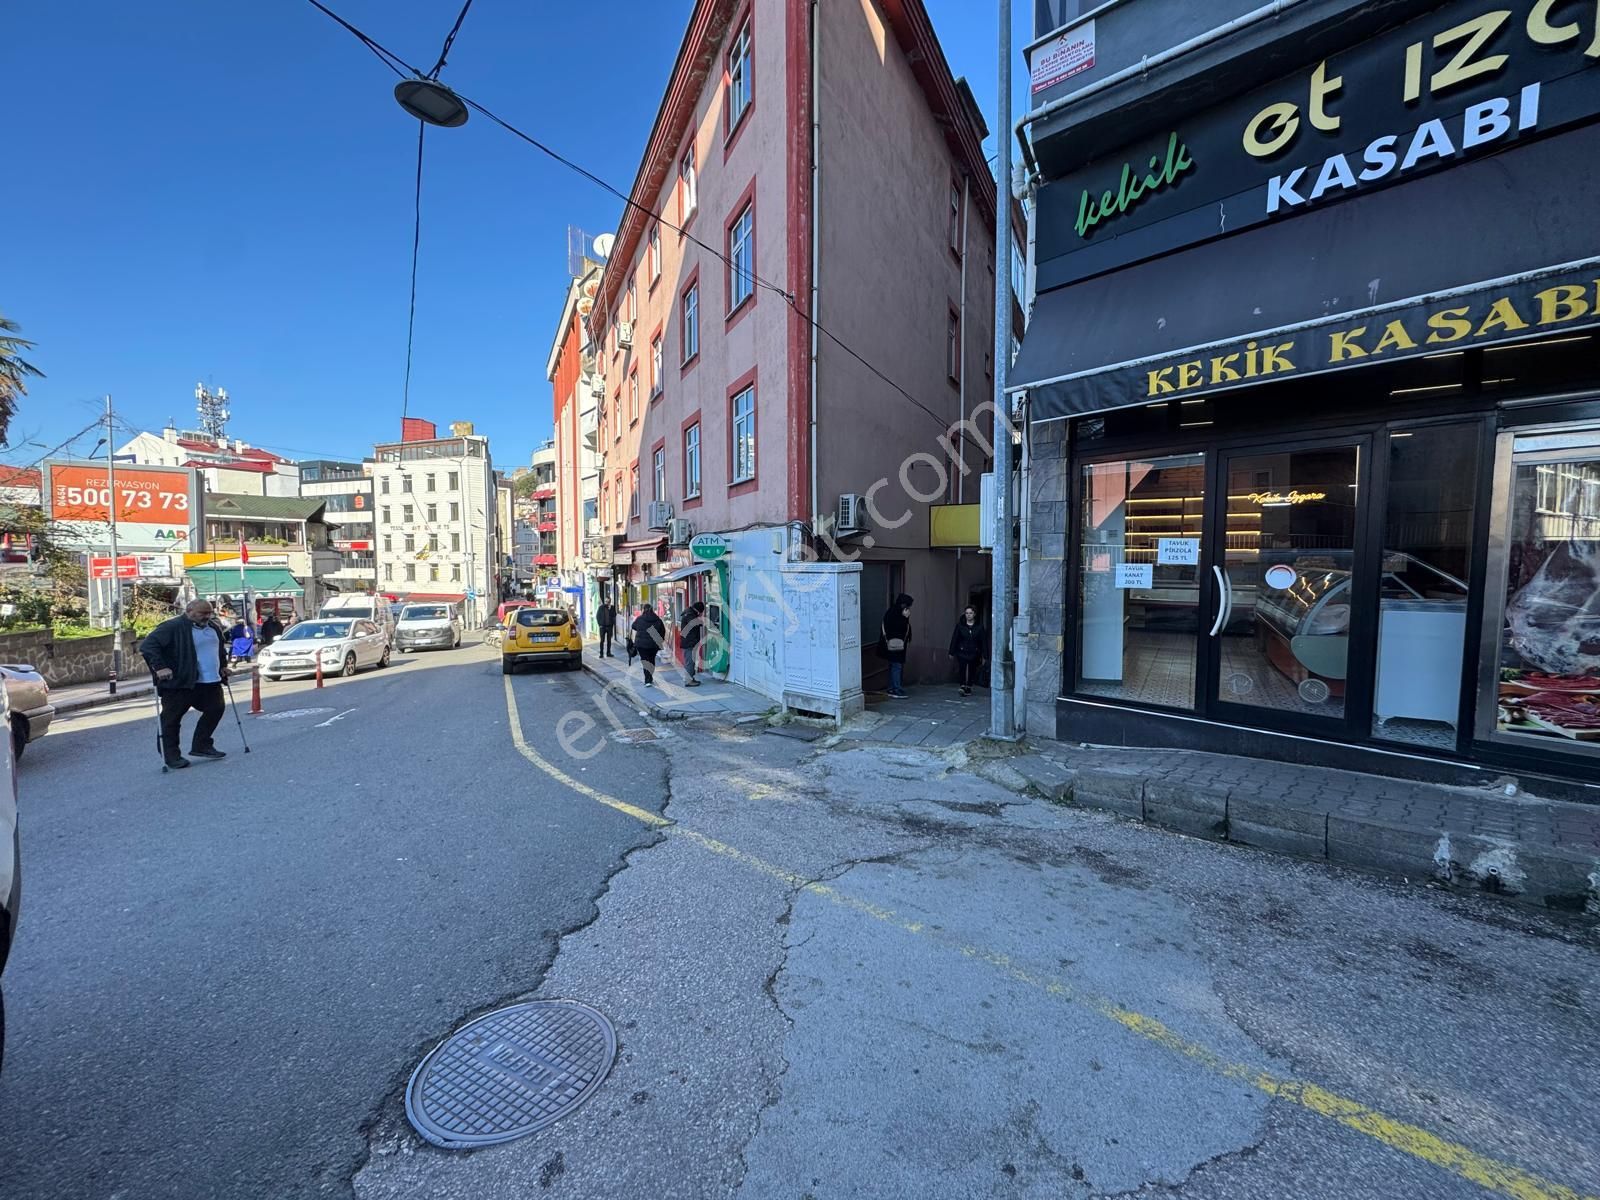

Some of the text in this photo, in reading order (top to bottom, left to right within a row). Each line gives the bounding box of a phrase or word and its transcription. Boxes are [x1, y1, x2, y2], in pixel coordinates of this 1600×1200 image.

[1074, 131, 1192, 236] kekik
[1243, 60, 1343, 157] et
[1266, 82, 1541, 214] KASABI
[1147, 340, 1297, 397] KEKİK
[121, 491, 152, 508] 73
[159, 493, 188, 510] 73
[487, 1043, 552, 1085] TELEFON
